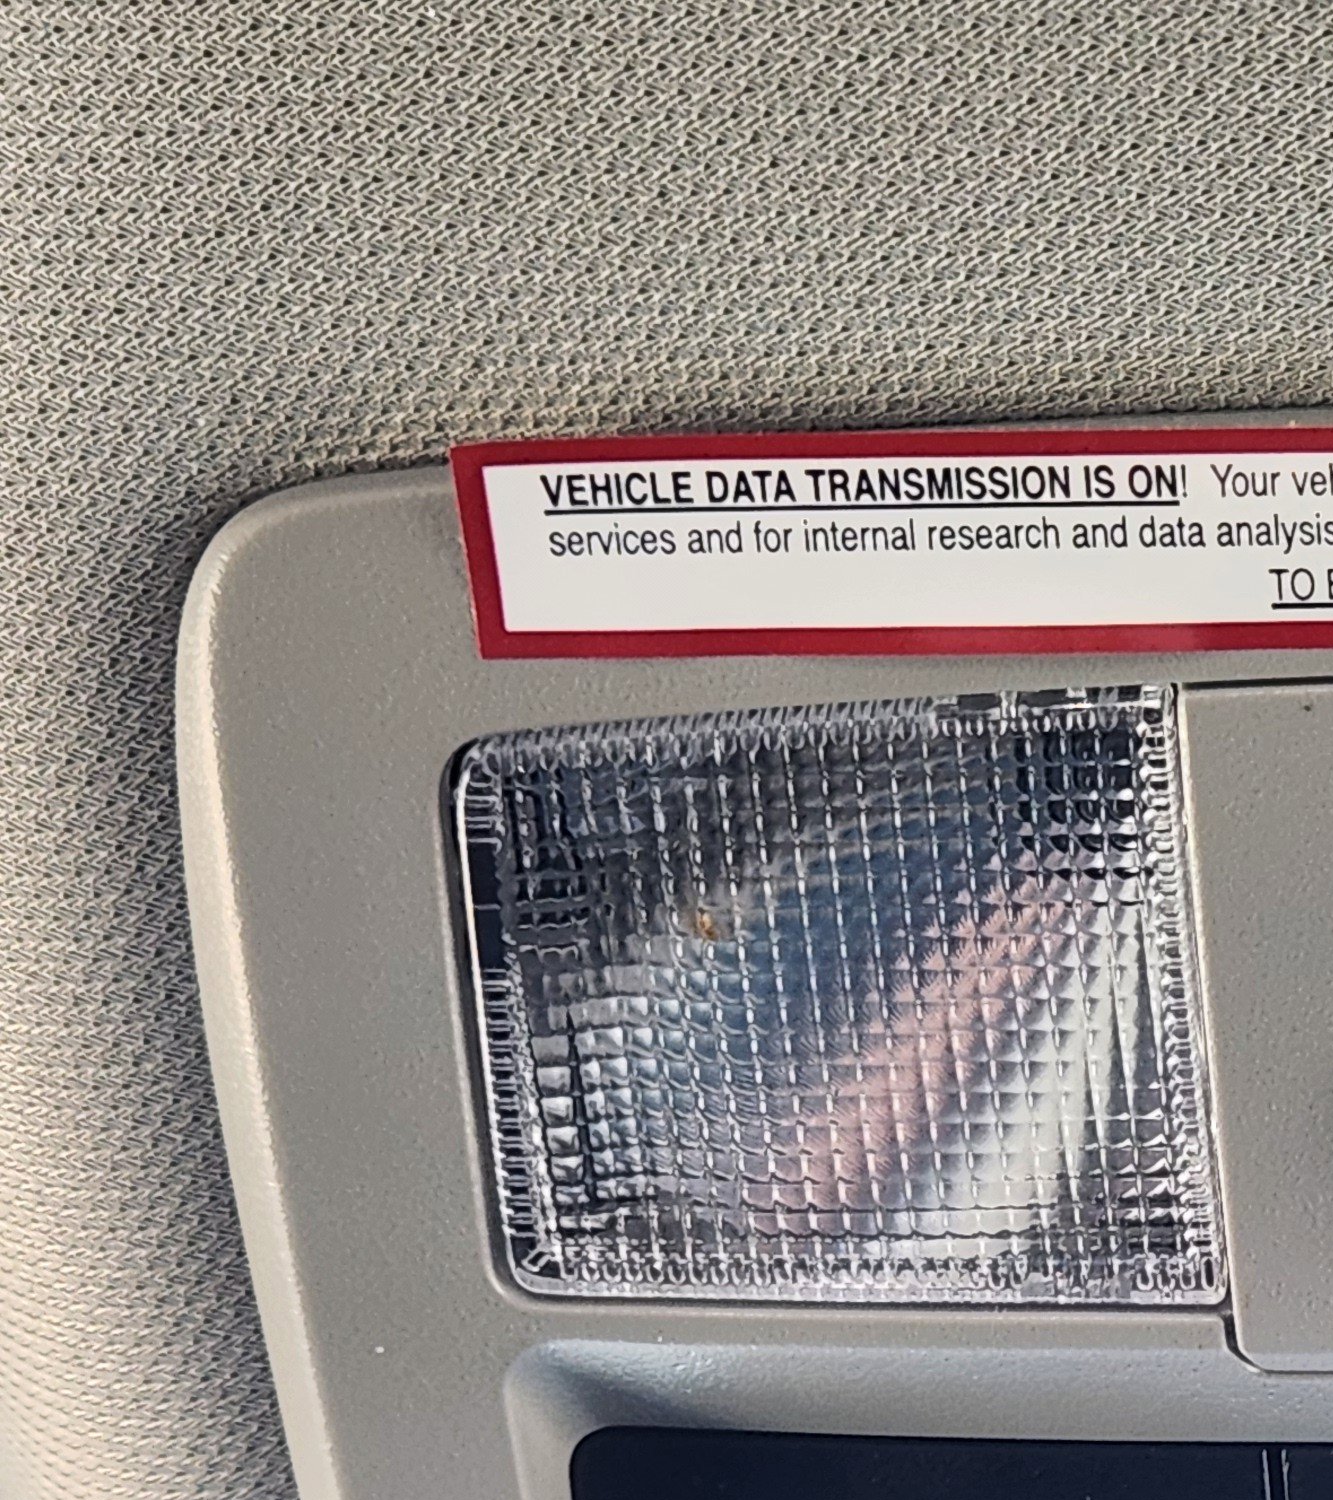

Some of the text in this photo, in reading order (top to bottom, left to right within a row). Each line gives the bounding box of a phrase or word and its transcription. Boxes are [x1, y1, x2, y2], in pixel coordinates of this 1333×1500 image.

[541, 470, 694, 507] VEHICLE
[706, 468, 795, 503] DATA
[804, 466, 1070, 502] TRANSMISSION
[1084, 465, 1115, 498] IS
[1129, 465, 1187, 498] ON!
[1211, 464, 1280, 497] Your
[549, 523, 676, 556] services
[688, 521, 742, 553] and
[754, 521, 792, 552] for
[804, 519, 915, 551] internal
[928, 517, 1060, 550] research
[1073, 516, 1127, 548] and
[1139, 516, 1206, 547] data
[1269, 568, 1314, 601] TO
